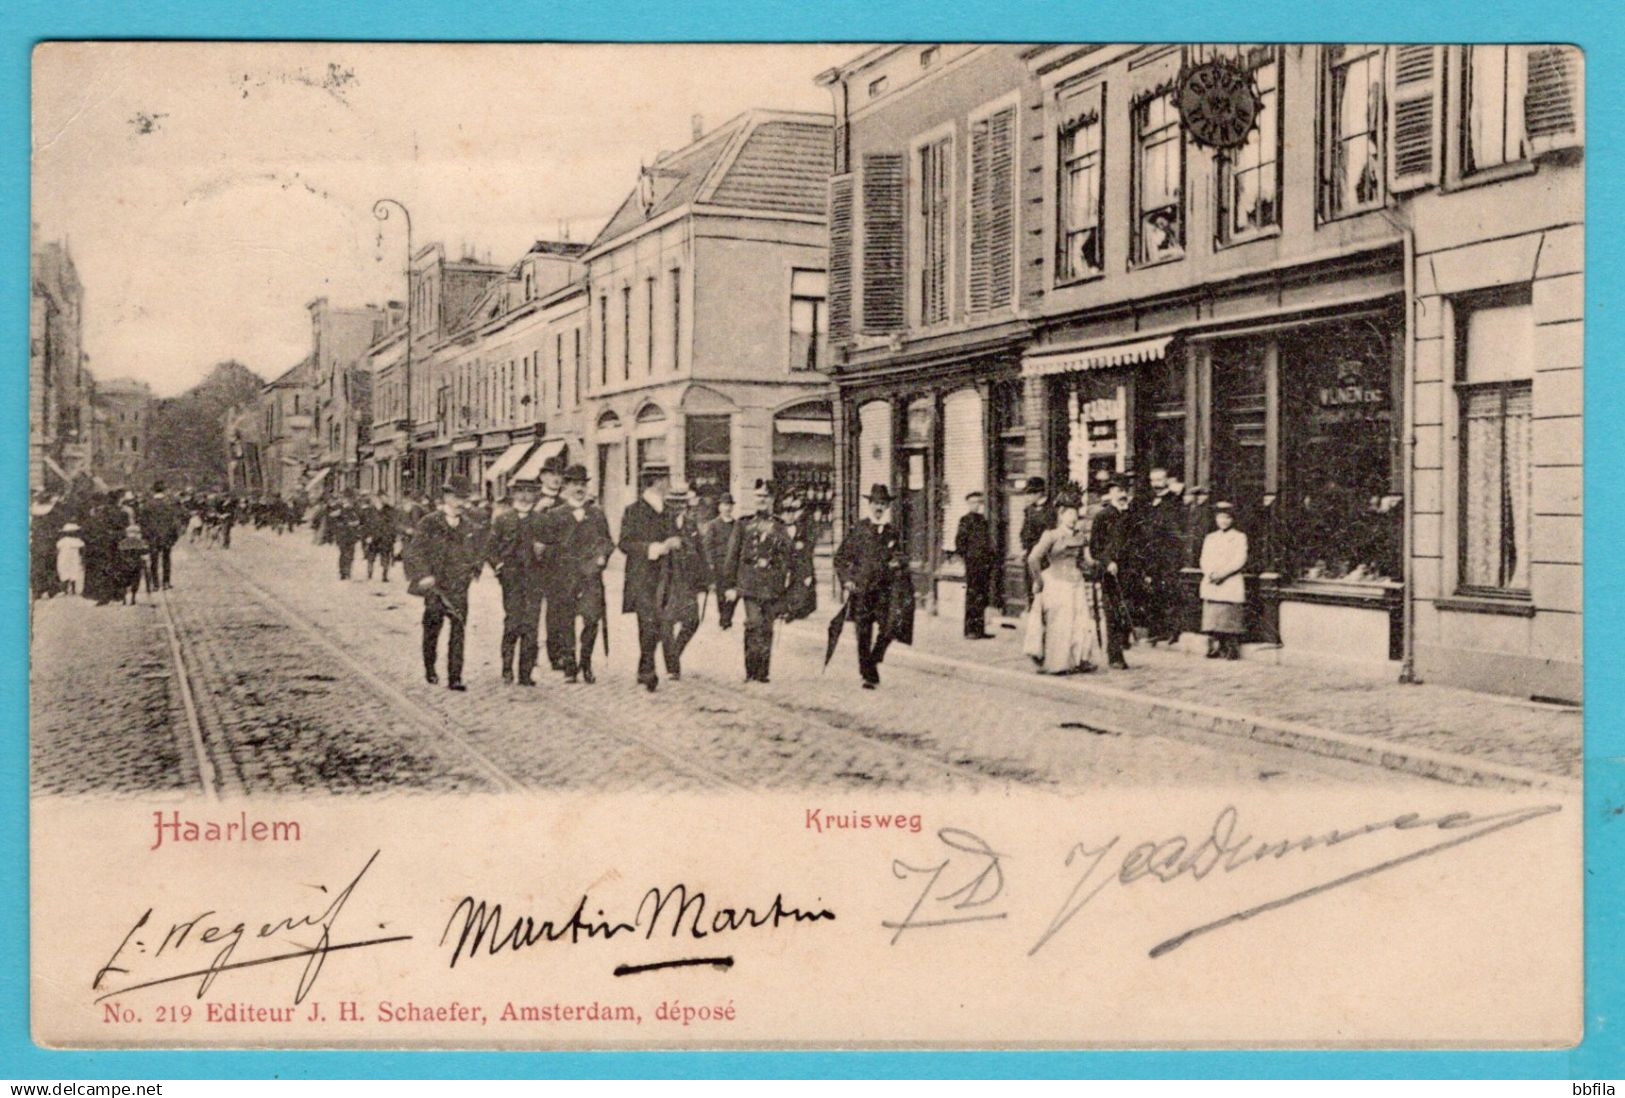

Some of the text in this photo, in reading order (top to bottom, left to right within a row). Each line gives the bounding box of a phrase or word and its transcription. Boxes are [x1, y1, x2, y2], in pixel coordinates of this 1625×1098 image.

[152, 811, 303, 850] Haarlem
[806, 810, 922, 834] Kruisweg
[438, 884, 836, 969] Martin Martin
[103, 1000, 737, 1026] No. 219 Editeur J. H. Schaefer, Amsterdam, déposé
